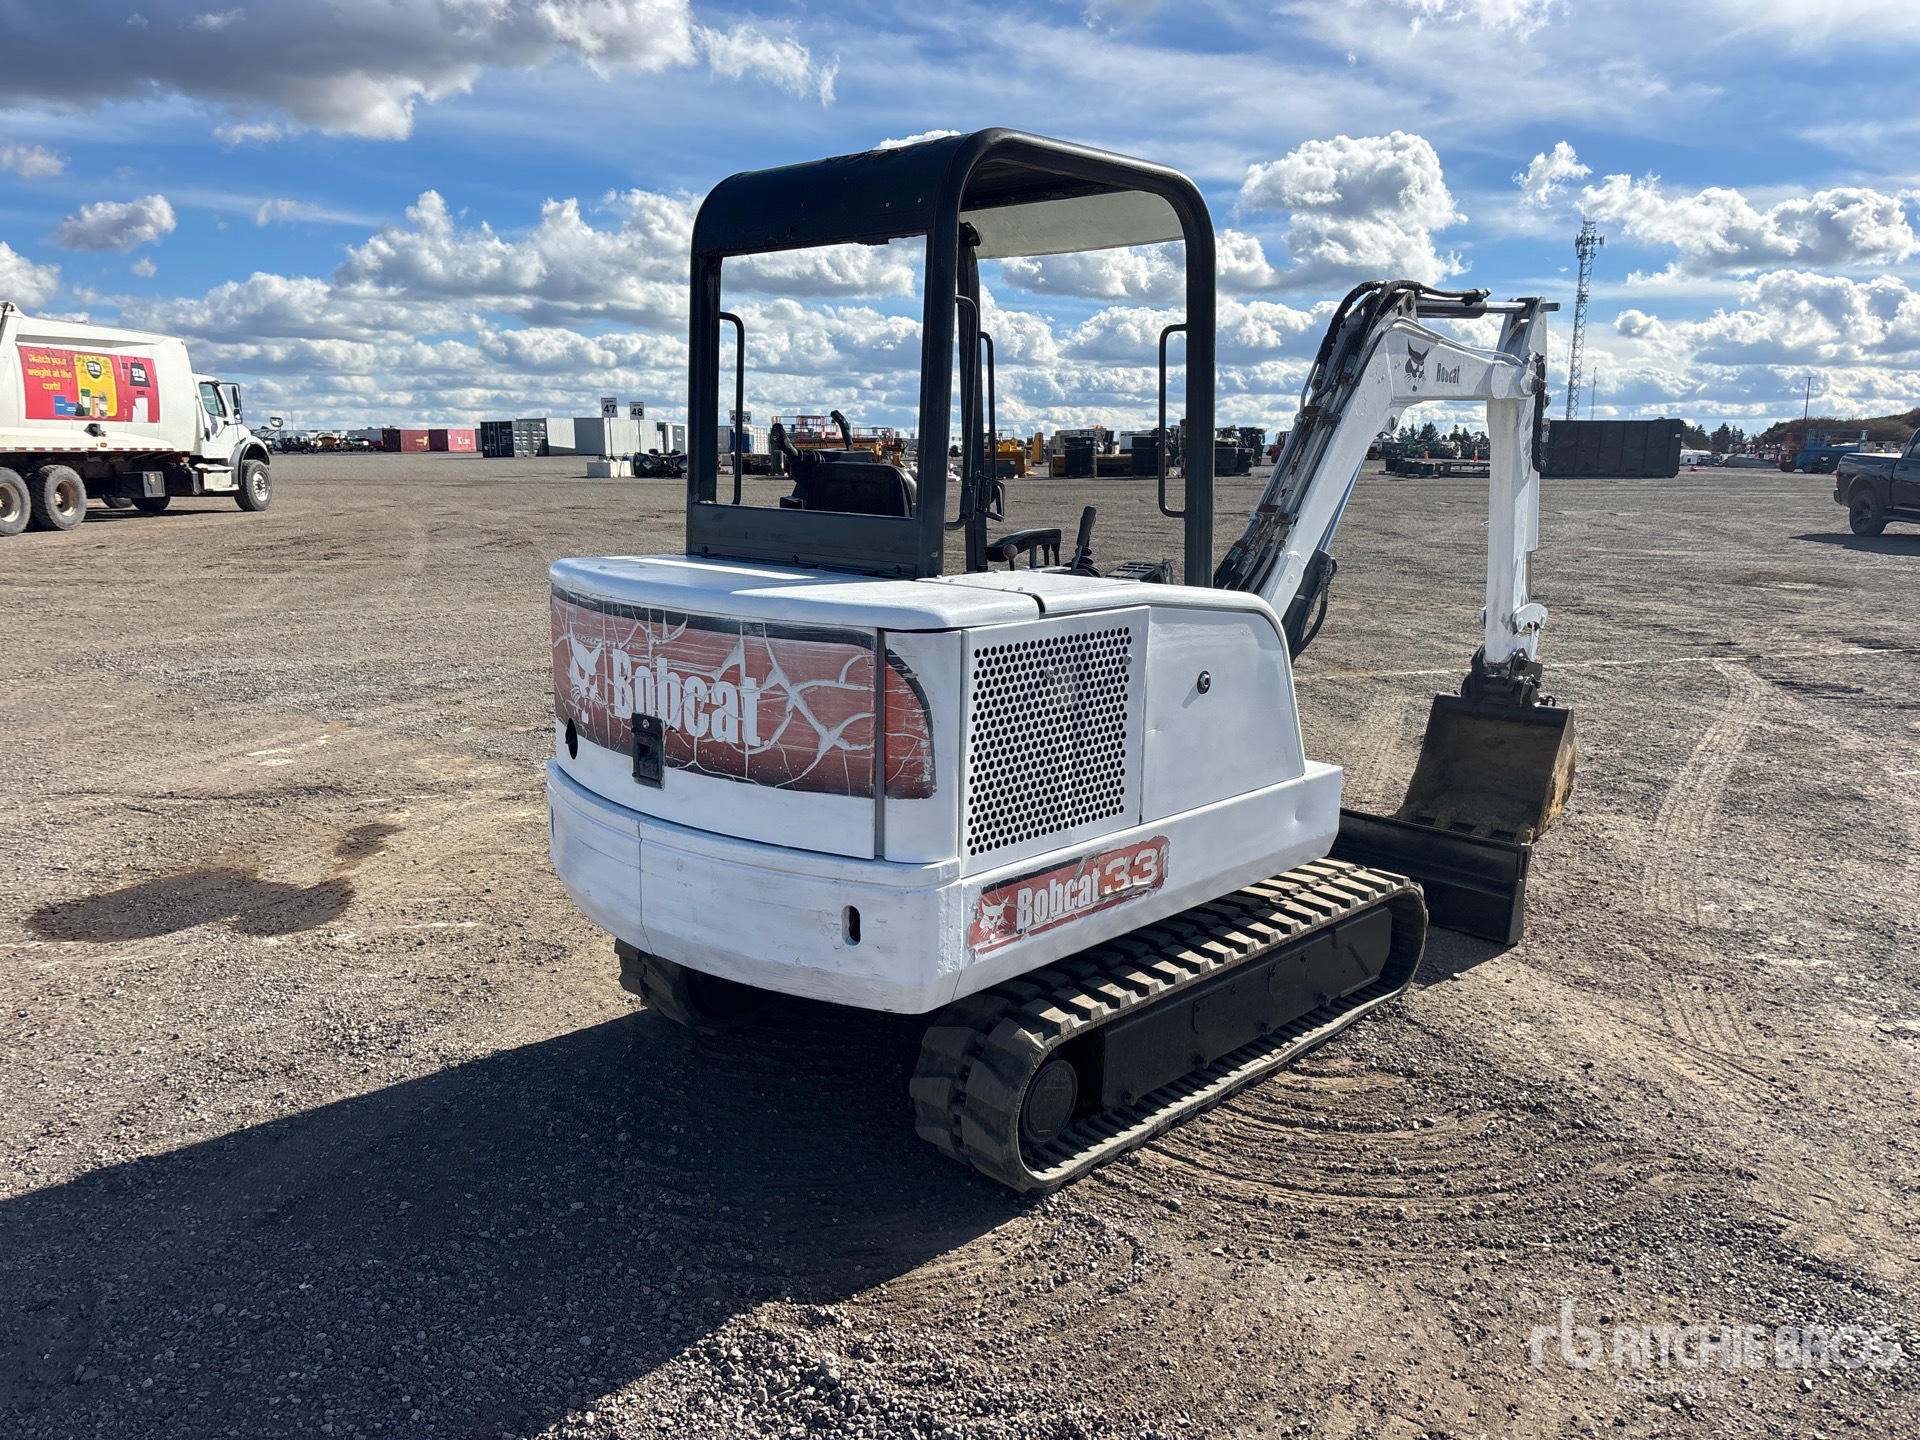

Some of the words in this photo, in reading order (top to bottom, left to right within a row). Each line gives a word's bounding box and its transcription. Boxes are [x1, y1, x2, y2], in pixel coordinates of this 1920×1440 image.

[27, 368, 51, 378] weight
[52, 370, 60, 378] at
[60, 370, 72, 378] the
[1436, 362, 1460, 384] Bobcat
[603, 404, 616, 413] 47
[631, 408, 643, 416] 48
[612, 648, 761, 746] Bobcat
[1016, 868, 1100, 930] Bobcat
